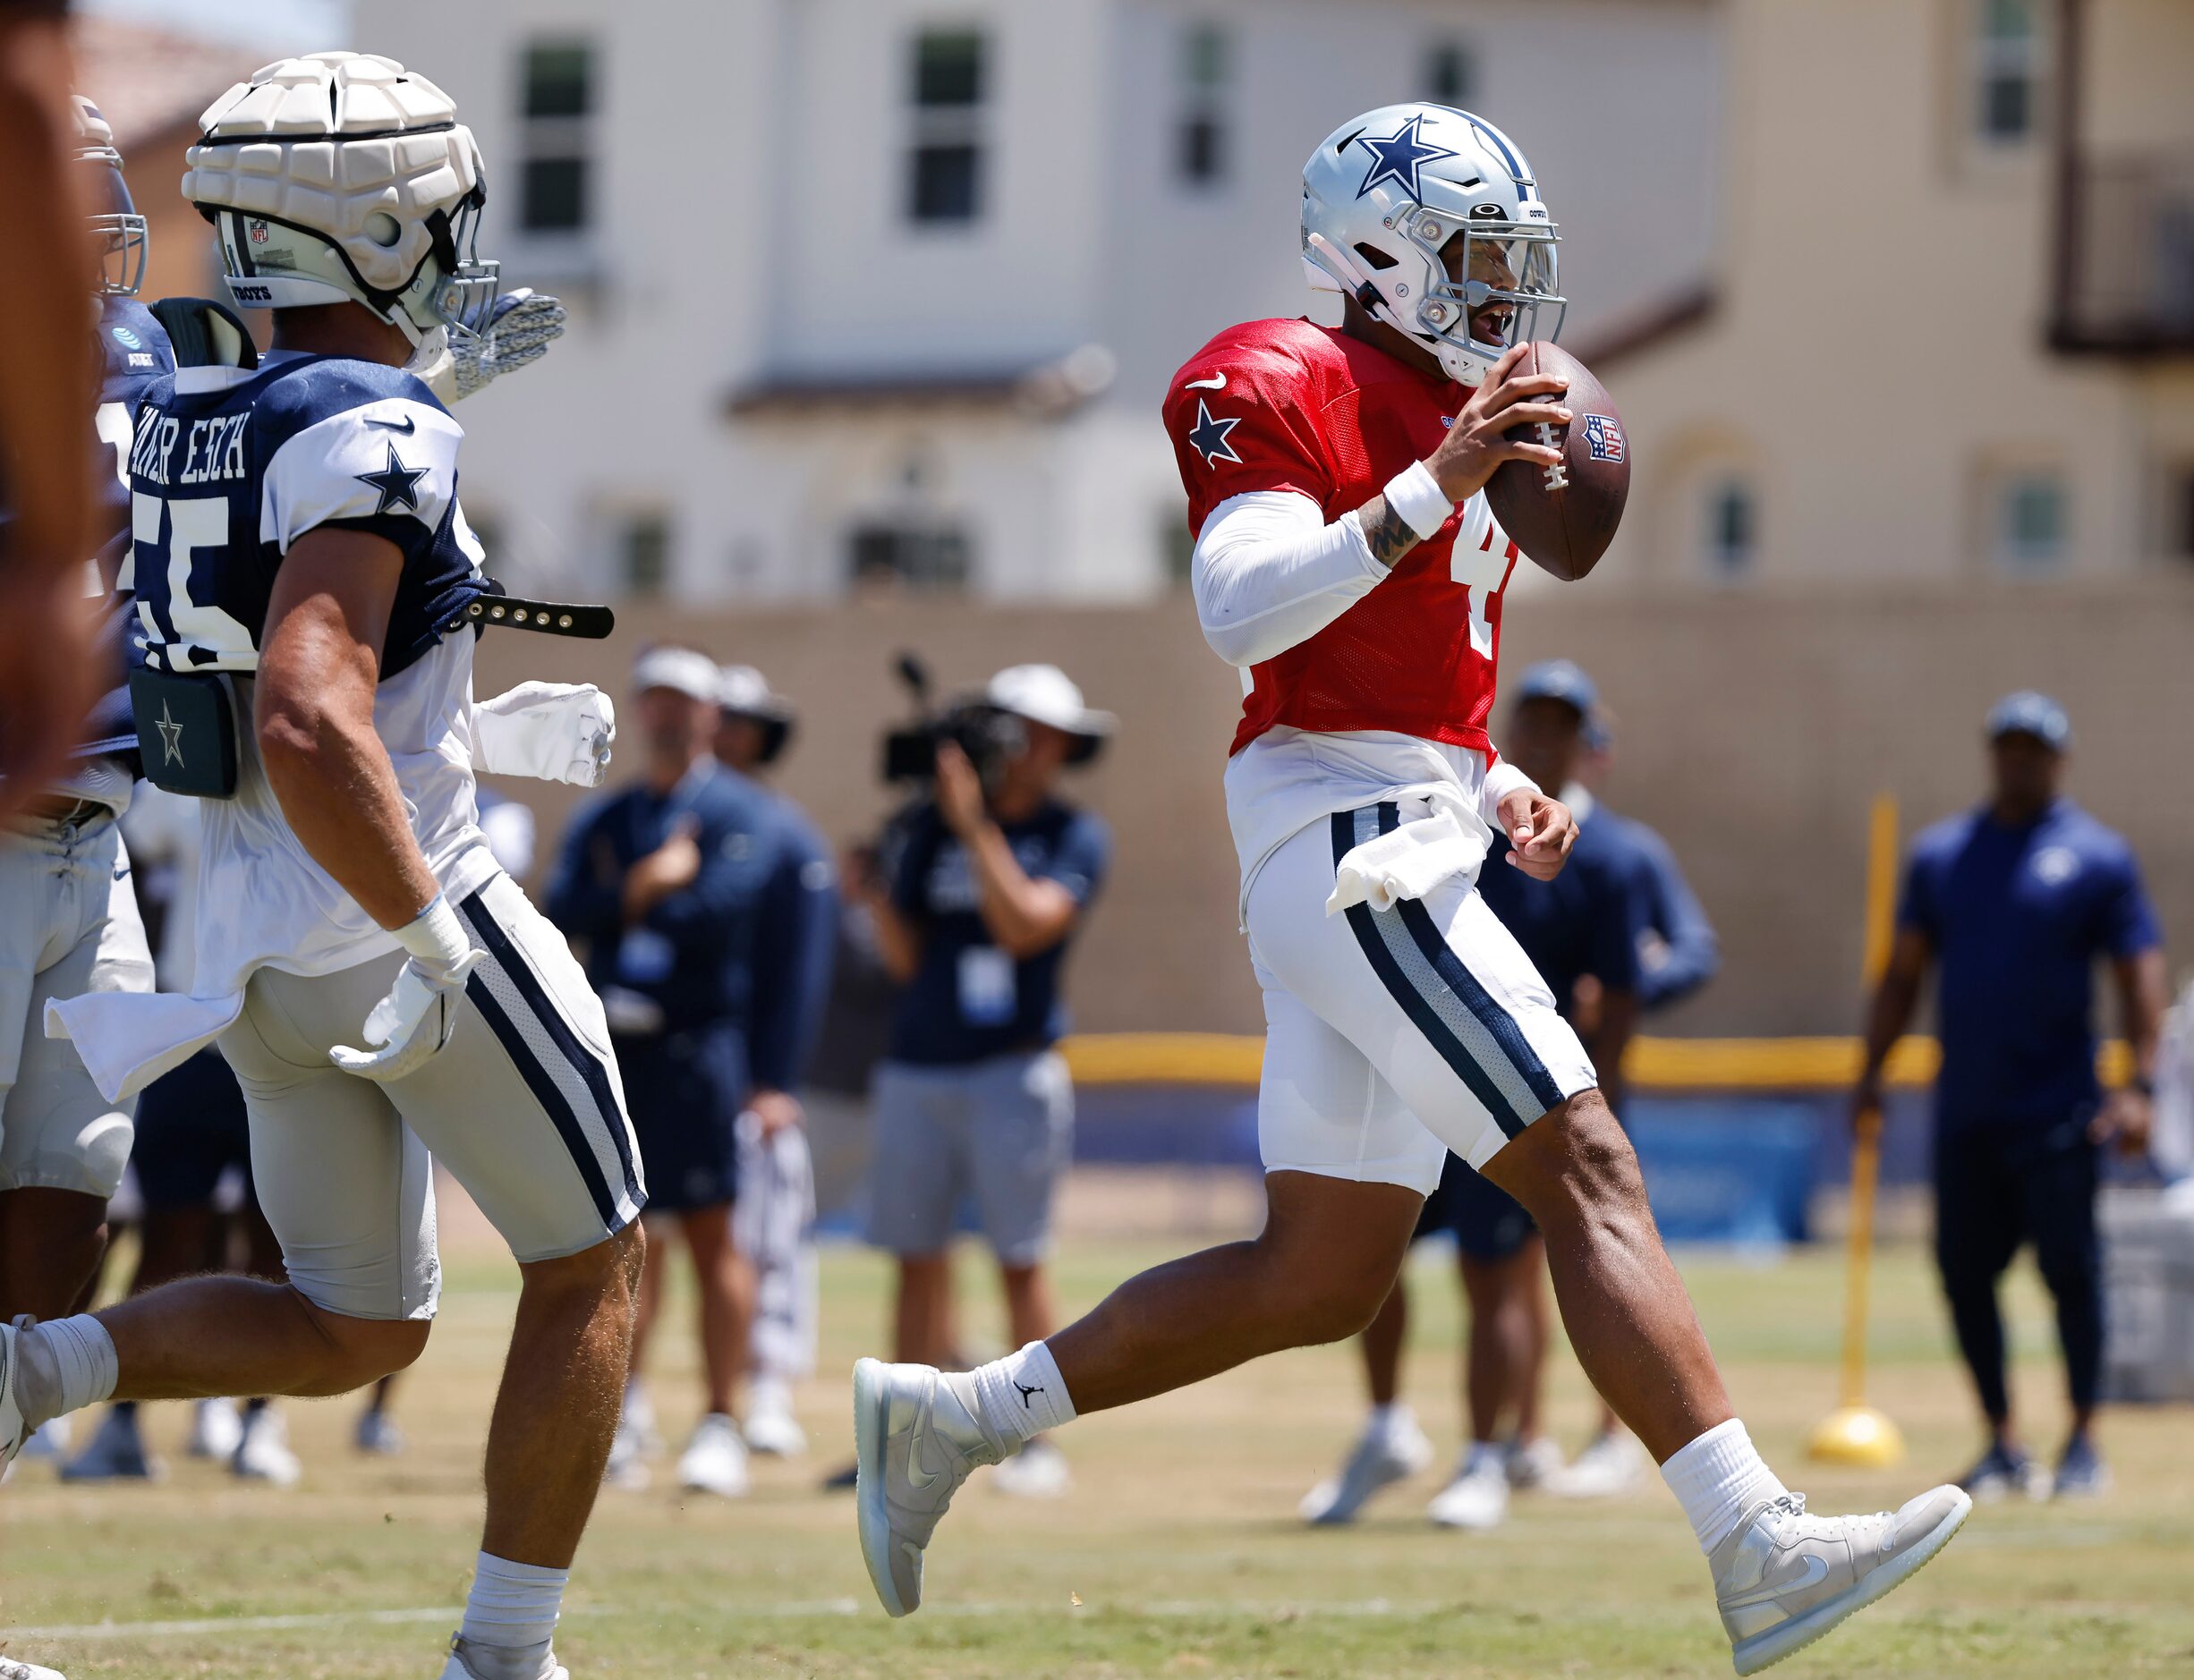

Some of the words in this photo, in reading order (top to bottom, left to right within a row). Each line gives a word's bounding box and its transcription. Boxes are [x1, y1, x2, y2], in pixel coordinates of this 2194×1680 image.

[251, 229, 267, 242] NFL
[128, 353, 154, 367] AT&T
[180, 411, 251, 484] ESCH
[1603, 422, 1622, 458] NFL
[1450, 486, 1511, 662] 4
